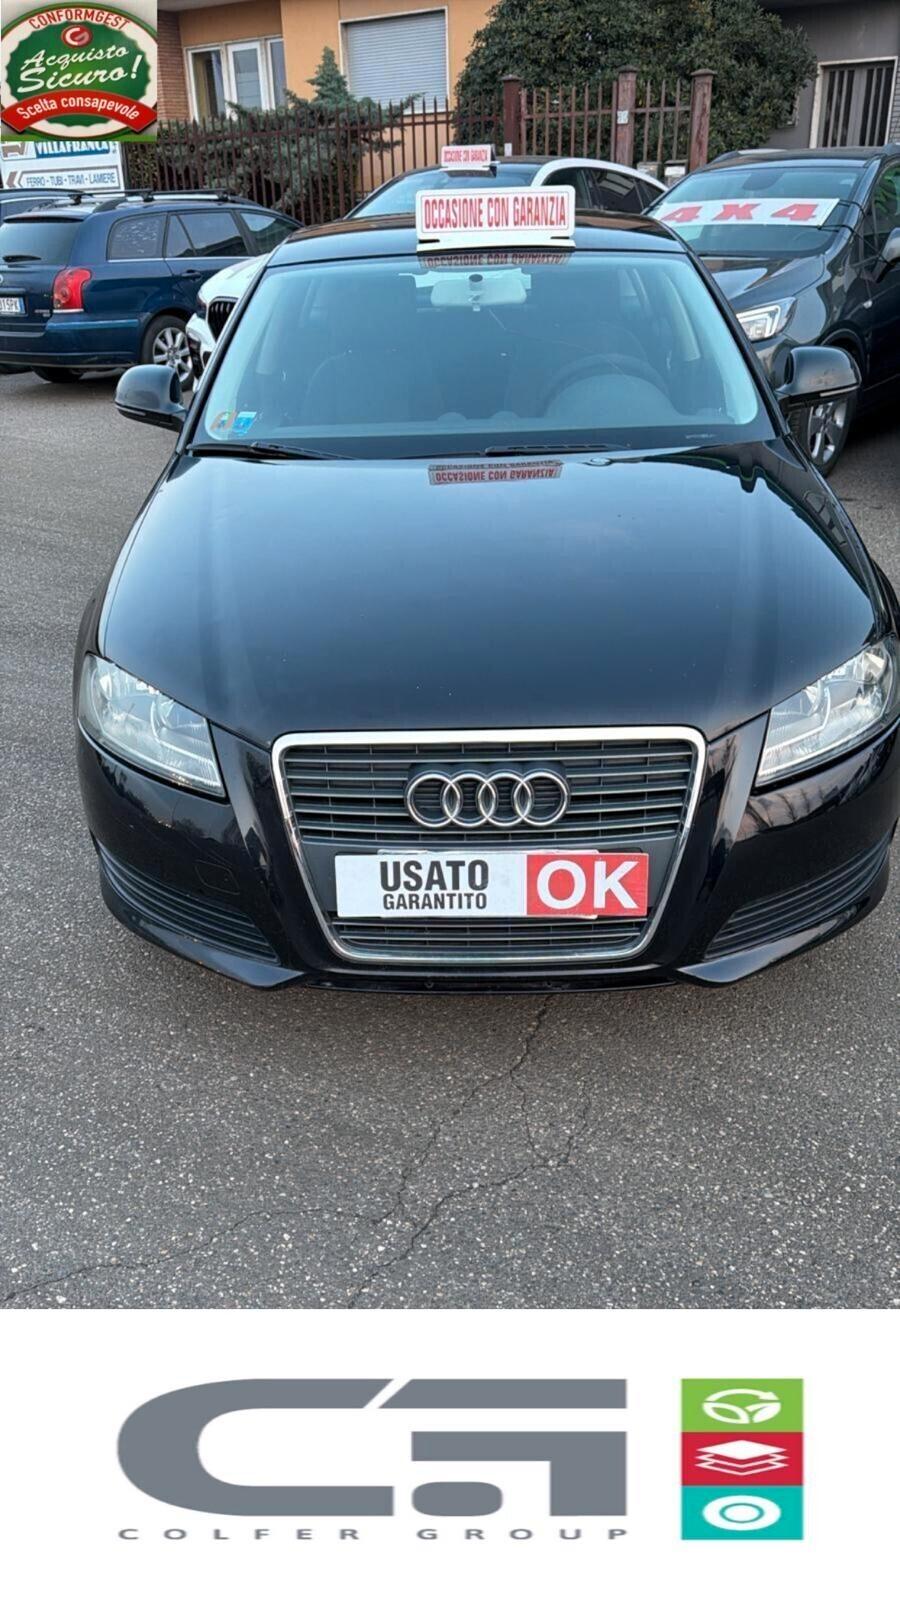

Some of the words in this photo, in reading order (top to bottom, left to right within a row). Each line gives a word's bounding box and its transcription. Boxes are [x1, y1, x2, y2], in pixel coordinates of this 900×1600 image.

[424, 198, 483, 229] OCCASIONE
[487, 197, 509, 227] CON
[513, 196, 566, 226] GARANZIA
[379, 859, 489, 892] USATO
[536, 859, 640, 910] OK
[383, 892, 488, 911] GARANTITO
